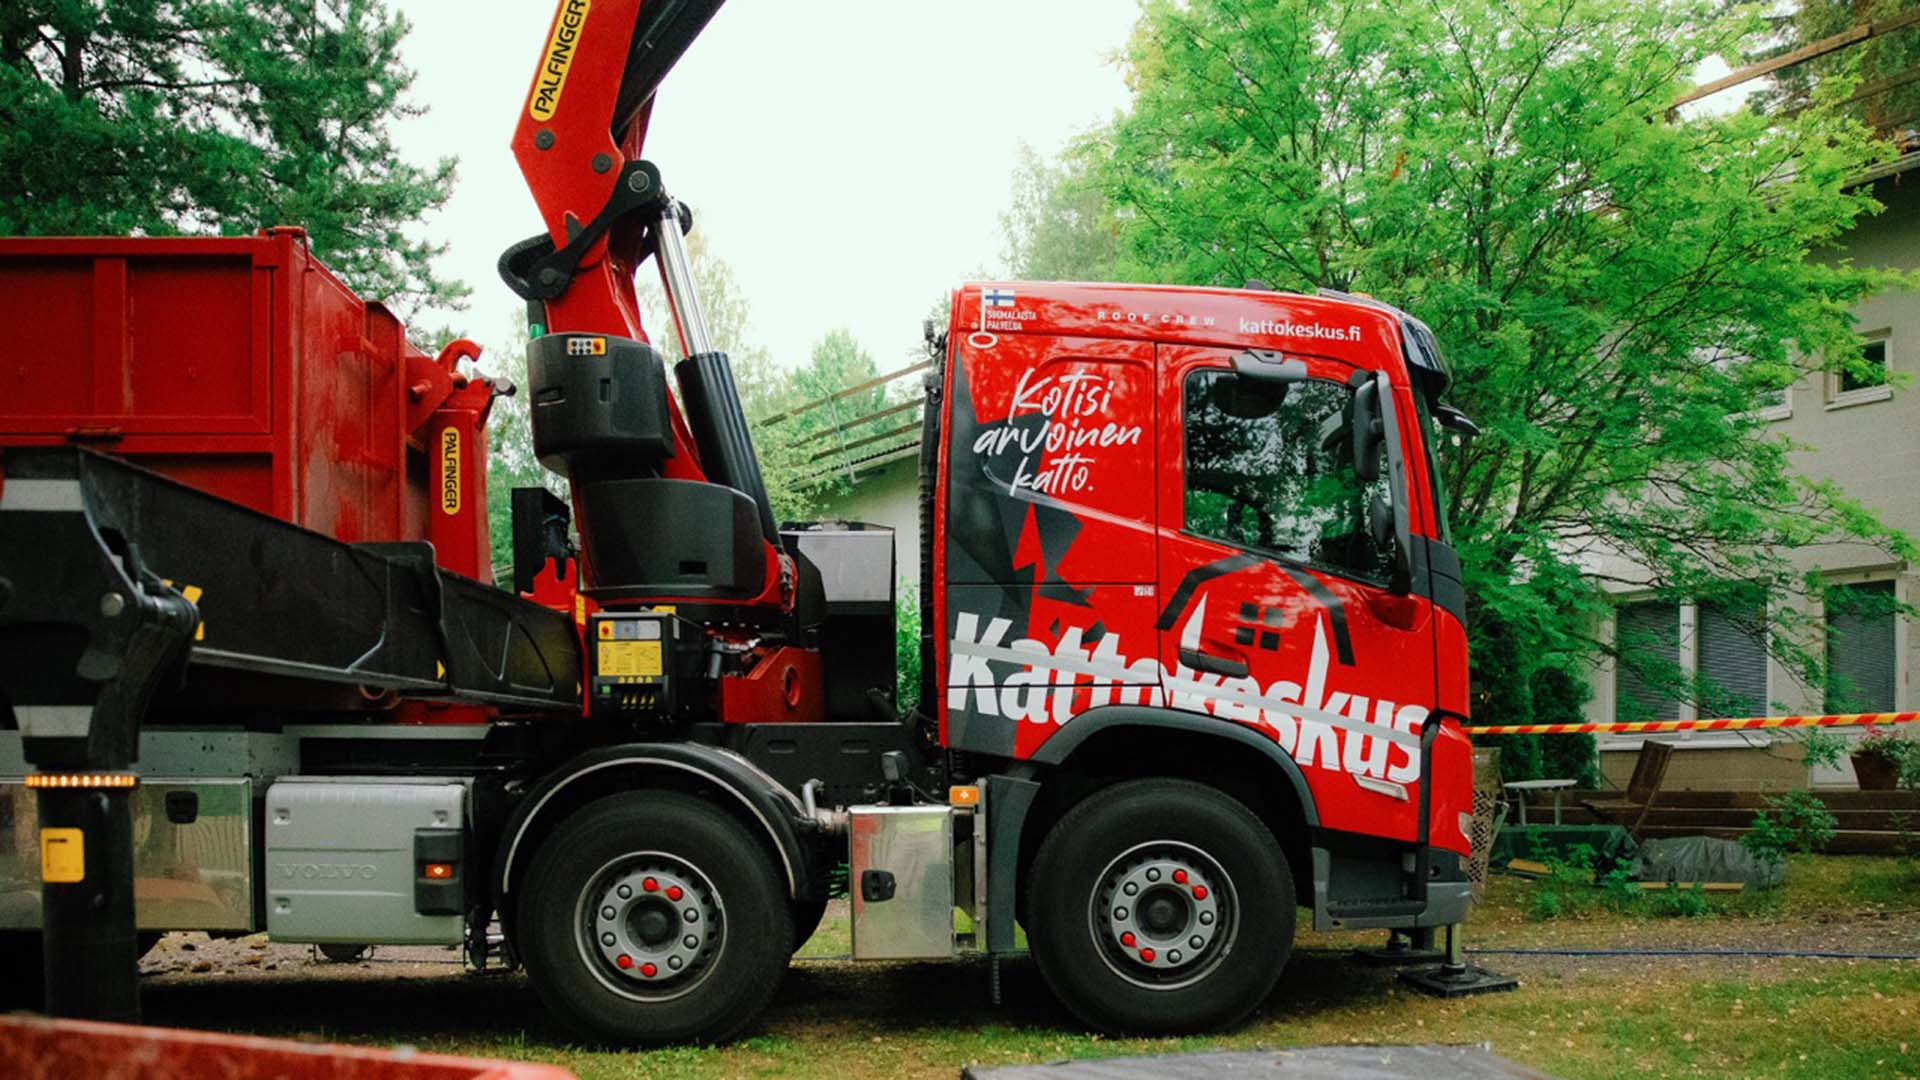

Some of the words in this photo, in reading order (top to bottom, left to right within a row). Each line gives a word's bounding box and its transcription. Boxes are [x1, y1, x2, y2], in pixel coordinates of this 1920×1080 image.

[534, 0, 586, 114] PALFINGER
[1098, 311, 1150, 322] ROOF
[1161, 314, 1216, 326] CREW
[1239, 317, 1361, 342] kattokeskus.fi
[1007, 367, 1115, 424] Kotisi
[973, 418, 1140, 458] arvoinen
[445, 432, 457, 509] PALFINGER
[1011, 453, 1094, 496] katto.
[273, 863, 377, 880] VOLVO
